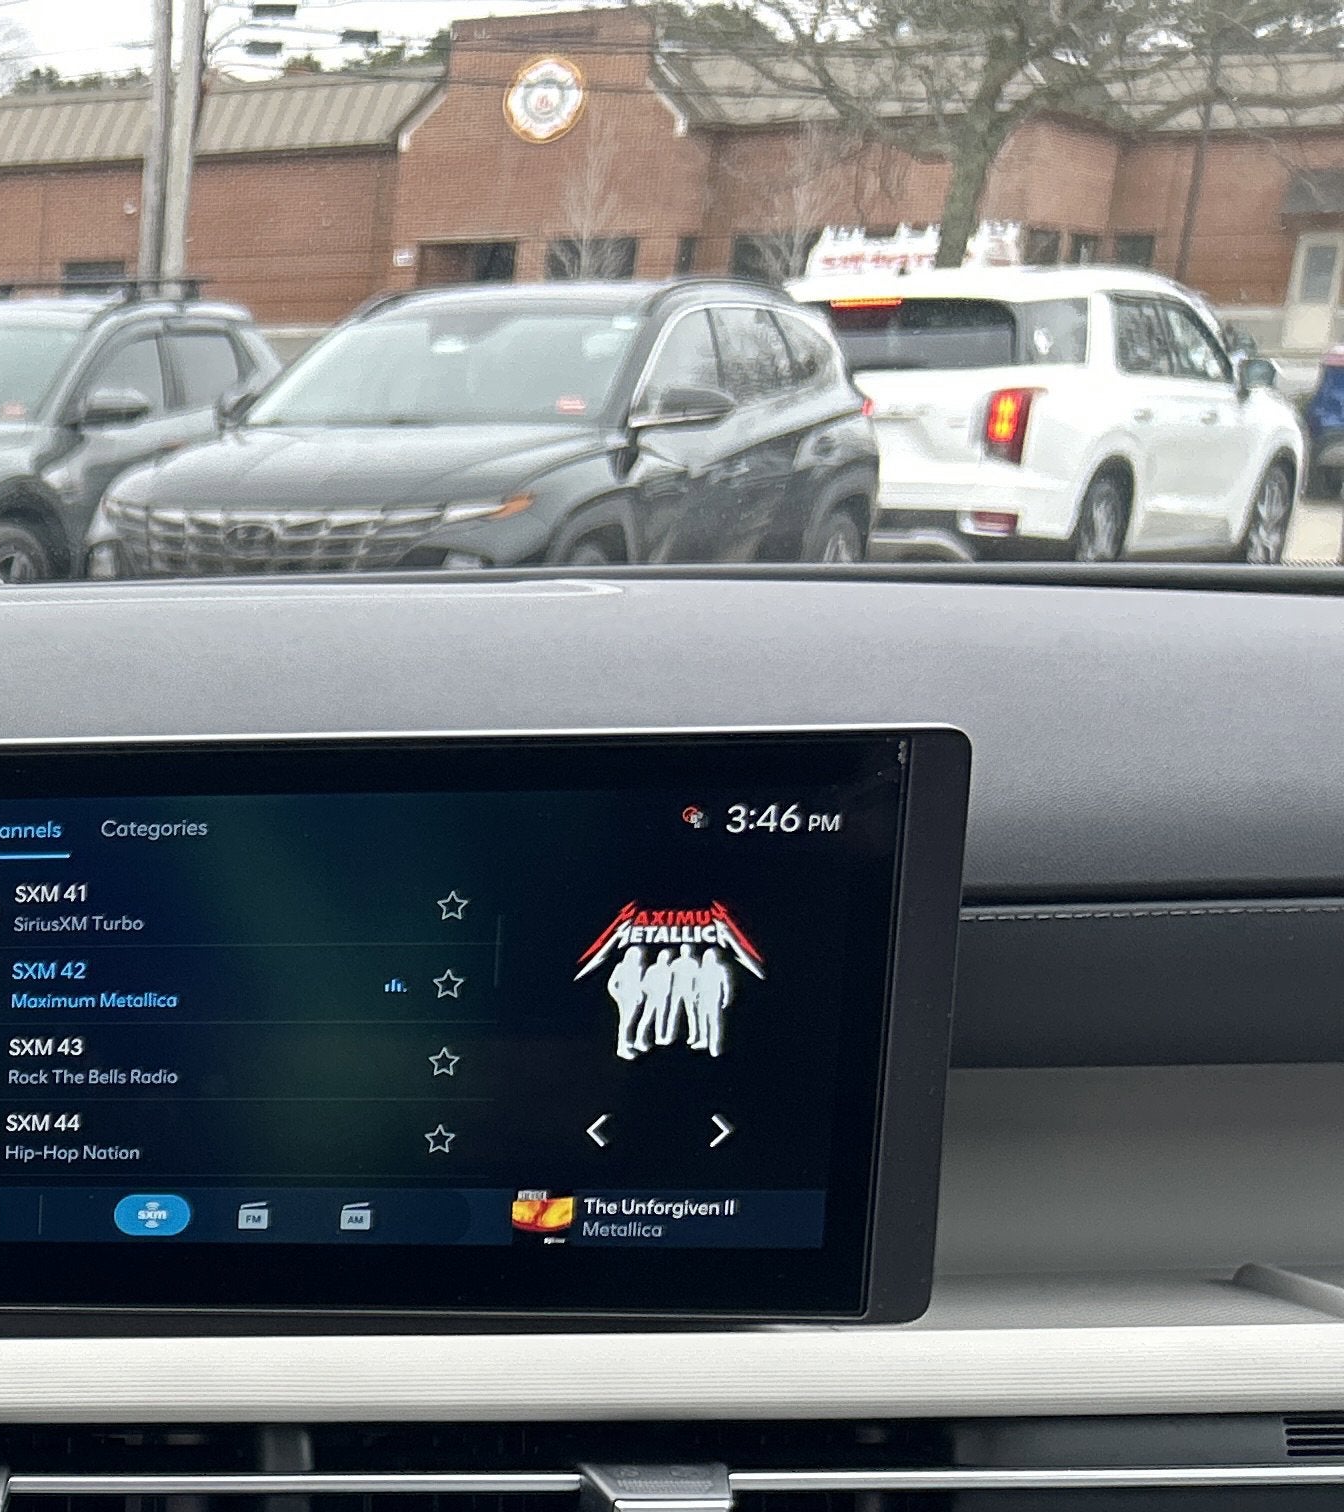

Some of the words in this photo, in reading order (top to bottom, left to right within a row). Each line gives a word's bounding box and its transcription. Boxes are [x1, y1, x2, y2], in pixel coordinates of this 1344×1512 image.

[726, 802, 802, 833] 3:46
[808, 813, 841, 832] PM
[100, 819, 208, 841] Categories
[14, 885, 59, 903] SXM
[63, 885, 88, 902] 41
[14, 915, 87, 932] SiriusXM
[92, 915, 144, 931] Turbo
[12, 963, 56, 979] SXM
[60, 962, 86, 979] 42
[12, 993, 95, 1008] Maximum
[100, 991, 178, 1008] Metallica
[9, 1039, 52, 1056] SXM
[57, 1038, 83, 1056] 43
[9, 1069, 48, 1085] Rock
[52, 1069, 85, 1085] The
[89, 1069, 127, 1085] Bells
[131, 1069, 178, 1085] Radio
[6, 1114, 49, 1132] SXM
[53, 1114, 80, 1132] 44
[5, 1145, 79, 1164] Hip-Hop
[83, 1145, 140, 1160] Nation
[583, 1199, 616, 1215] The
[621, 1199, 719, 1219] Unforgiven
[724, 1200, 735, 1215] II
[245, 1214, 261, 1224] FM
[347, 1216, 363, 1225] AM
[582, 1221, 662, 1238] Metallica
